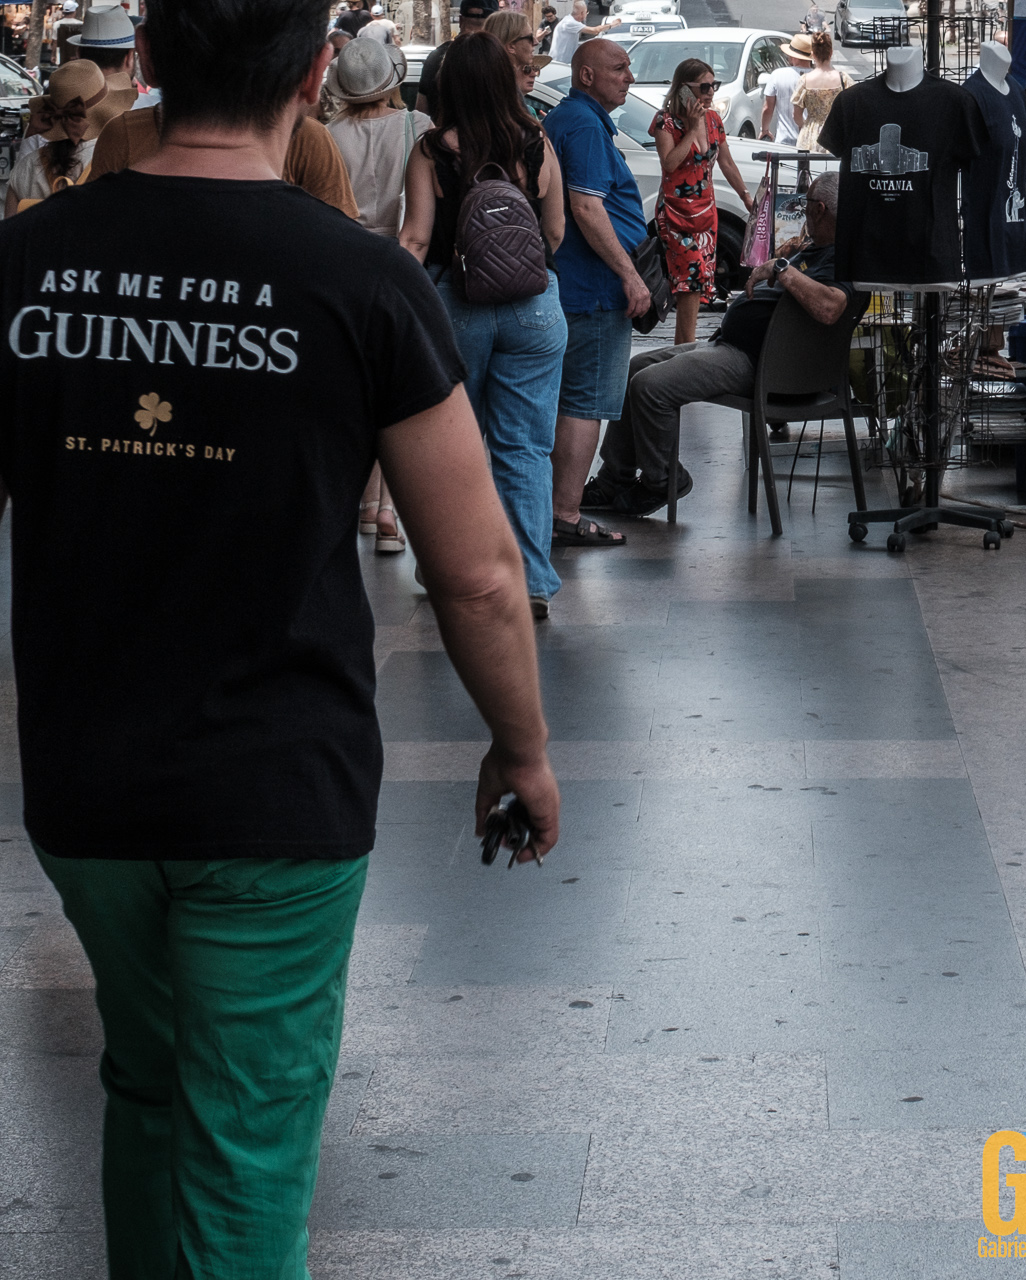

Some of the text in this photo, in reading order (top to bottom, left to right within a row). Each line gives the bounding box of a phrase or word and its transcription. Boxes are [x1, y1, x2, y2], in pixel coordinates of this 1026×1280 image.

[869, 179, 914, 191] CATANIA
[40, 269, 274, 307] ASK ME FOR A
[8, 305, 300, 374] GUINNESS
[65, 436, 237, 462] ST. PATRICK'S DAY
